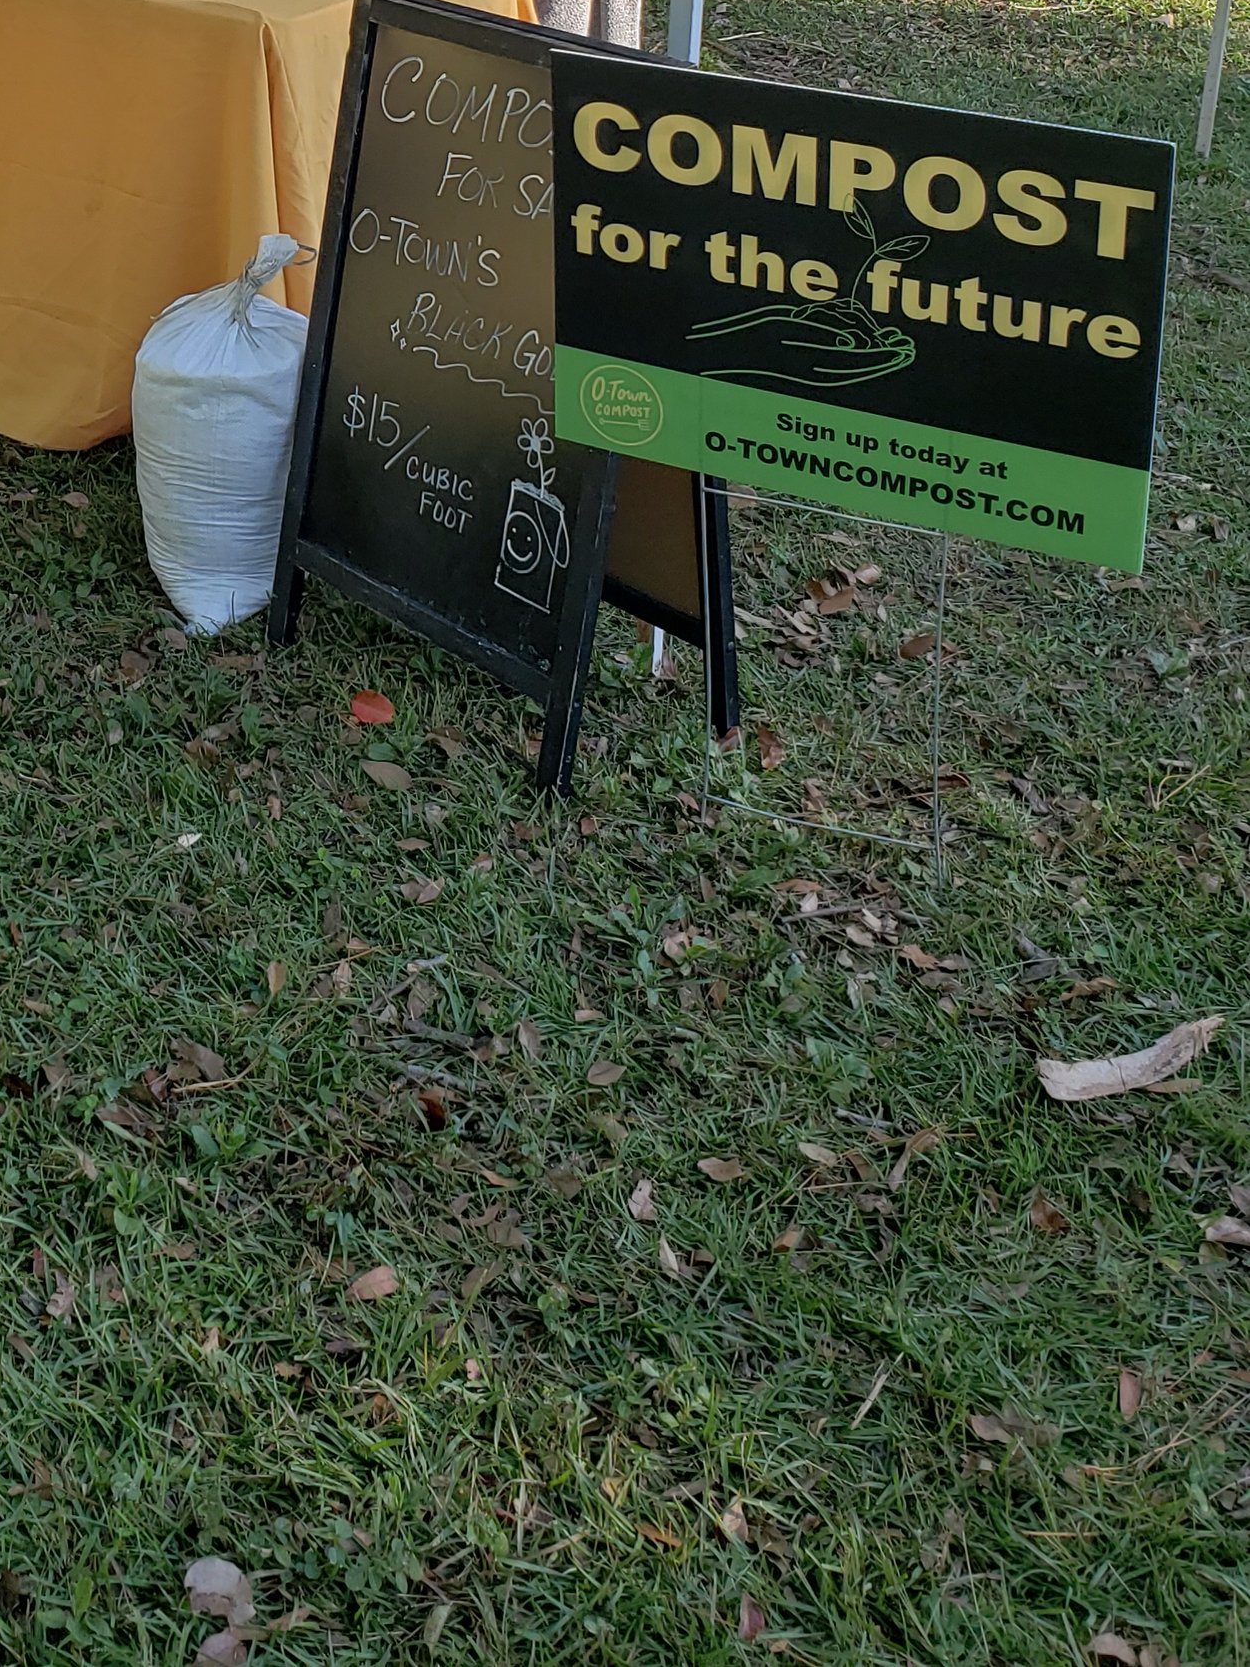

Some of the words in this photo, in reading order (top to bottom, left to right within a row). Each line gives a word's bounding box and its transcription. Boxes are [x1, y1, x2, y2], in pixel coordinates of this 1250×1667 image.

[381, 56, 553, 151] COMPO
[437, 152, 505, 208] FOR
[572, 100, 1156, 261] COMPOST
[350, 208, 501, 286] O-TOWN'S
[570, 203, 681, 270] for
[704, 230, 840, 302] the
[866, 259, 1141, 359] future
[406, 292, 513, 359] BLACK
[592, 376, 653, 403] O-Town
[595, 403, 651, 419] COMPOST
[406, 456, 474, 501] CUBIC
[776, 413, 836, 442] Sign
[845, 431, 879, 454] up
[888, 436, 970, 475] today
[978, 460, 1008, 480] at
[419, 491, 473, 534] FOOT
[705, 430, 1085, 535] O-TOWNCOMPOST.COM
